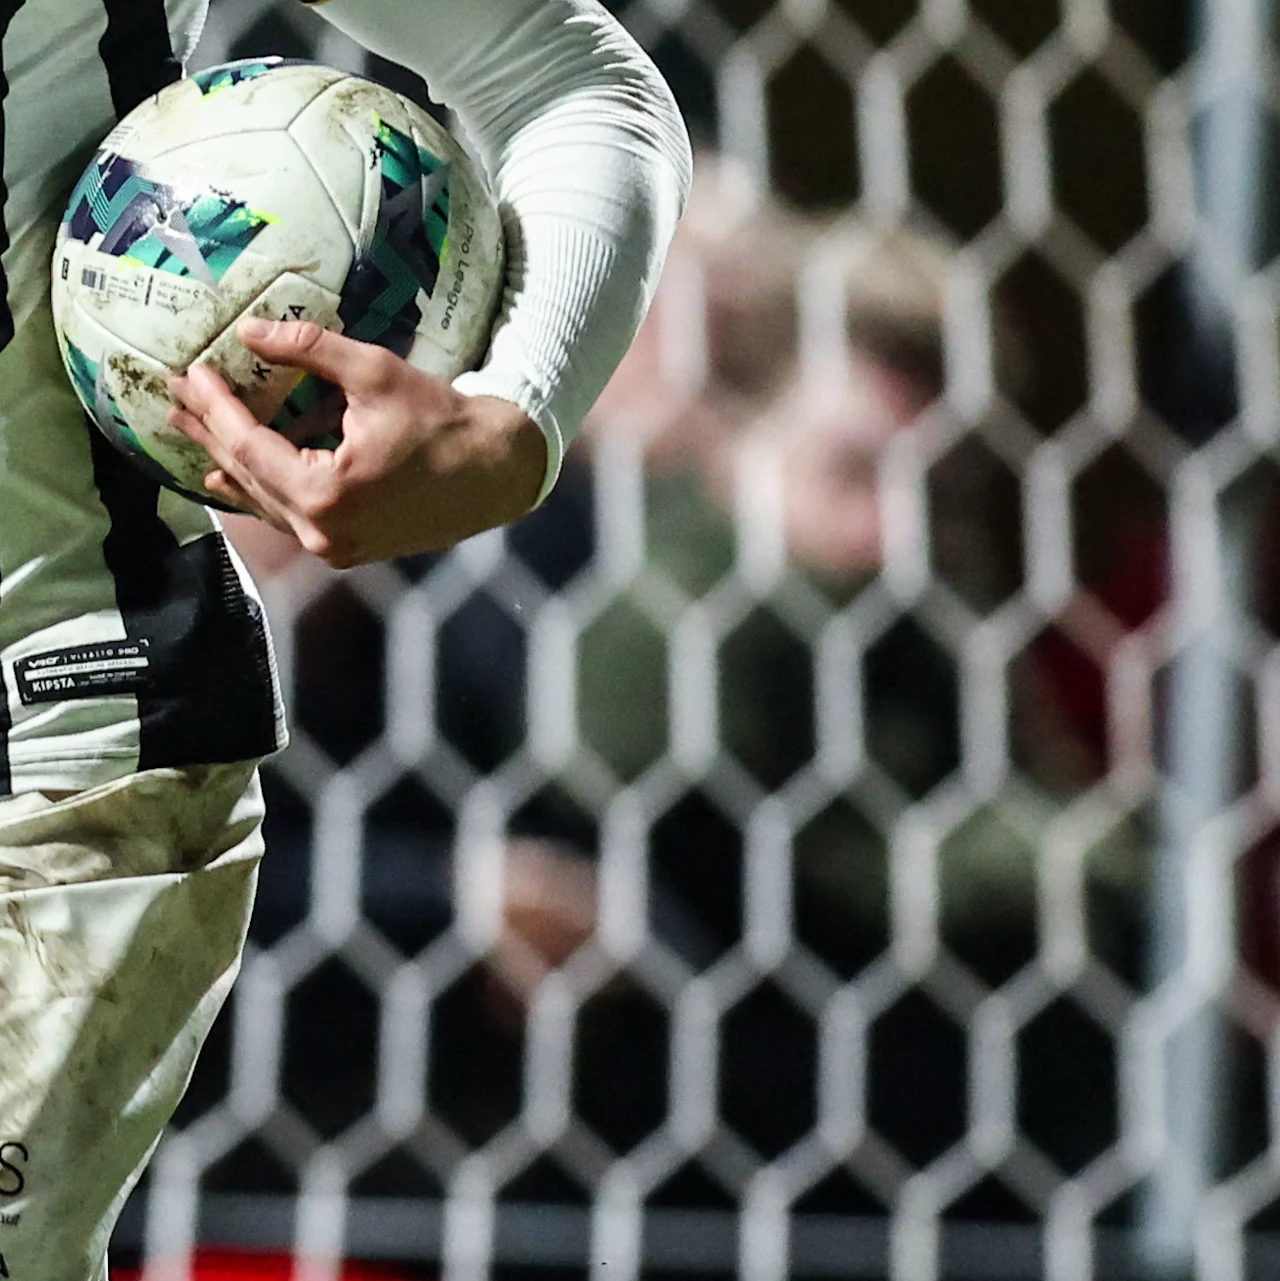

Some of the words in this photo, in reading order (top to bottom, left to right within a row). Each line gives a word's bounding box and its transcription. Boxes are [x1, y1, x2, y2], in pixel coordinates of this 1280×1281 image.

[461, 222, 474, 255] Pro
[440, 259, 470, 331] League
[32, 676, 76, 693] KIPSTA
